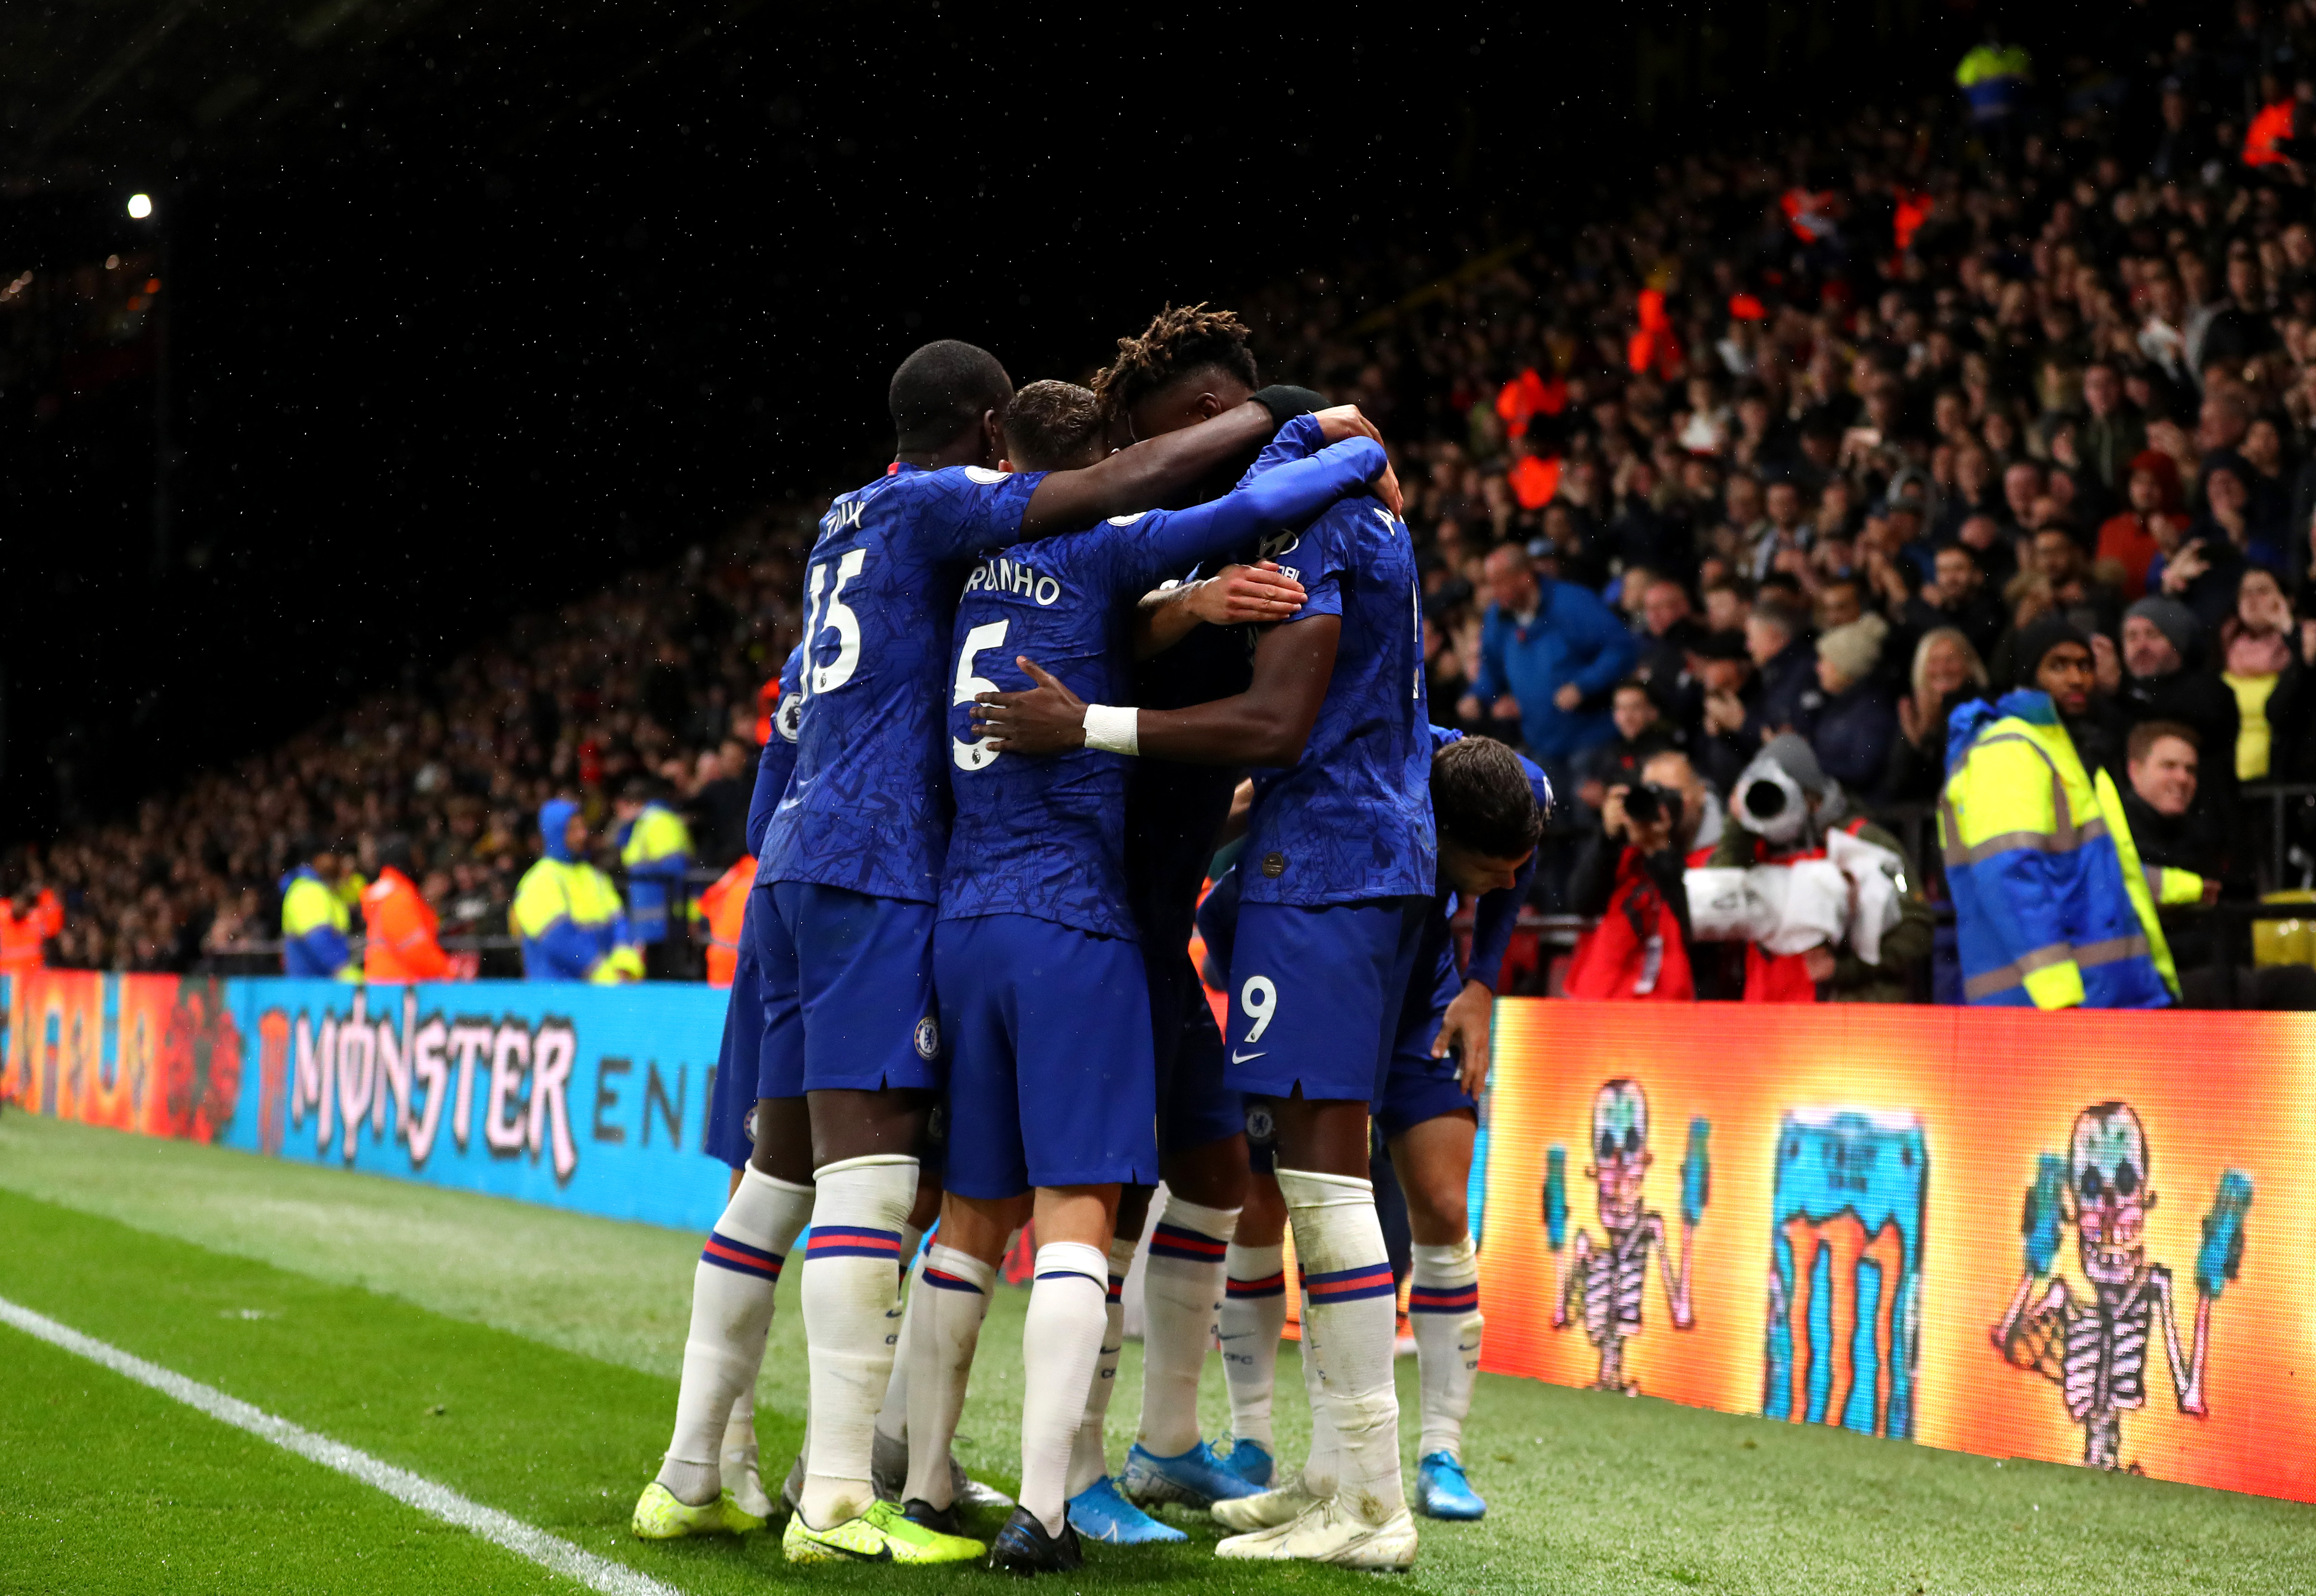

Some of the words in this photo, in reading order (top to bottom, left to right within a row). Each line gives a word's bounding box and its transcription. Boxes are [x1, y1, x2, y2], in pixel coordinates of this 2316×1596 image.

[800, 548, 866, 703] 15
[959, 558, 1060, 606] RGINHO
[953, 620, 1010, 771] 5
[292, 982, 577, 1187] MONSTER
[1241, 976, 1277, 1043] 9
